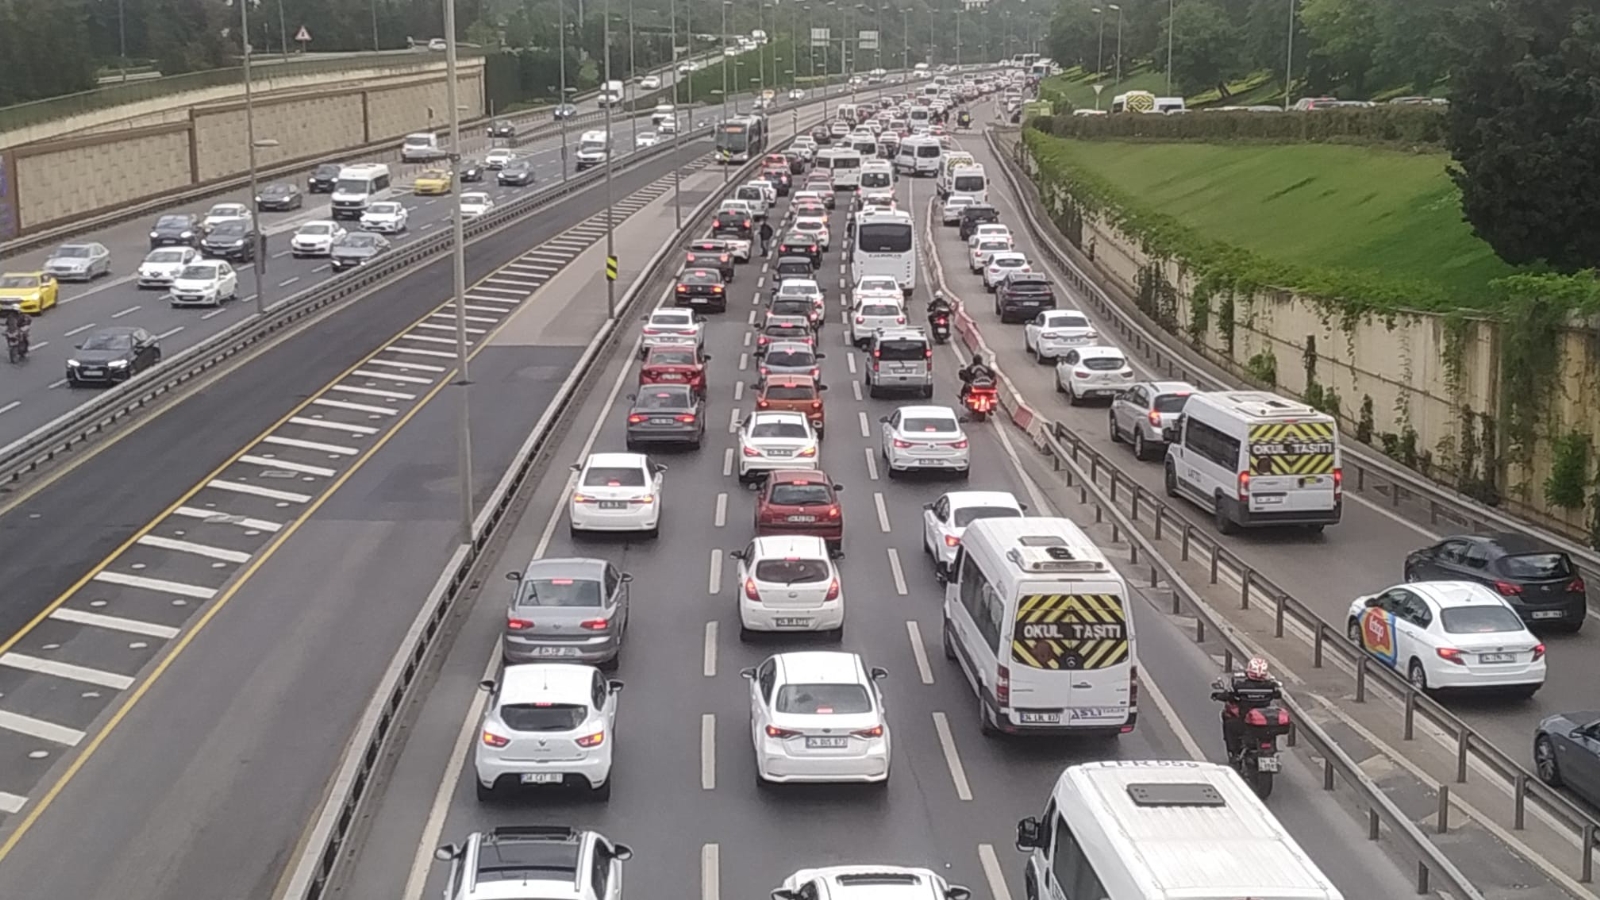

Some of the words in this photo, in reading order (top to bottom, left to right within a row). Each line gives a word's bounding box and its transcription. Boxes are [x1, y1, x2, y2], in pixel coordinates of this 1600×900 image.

[1252, 444, 1288, 455] OKUL
[1292, 443, 1332, 455] TAŞITI
[1023, 624, 1064, 639] OKUL
[1071, 624, 1121, 641] TAŞITI
